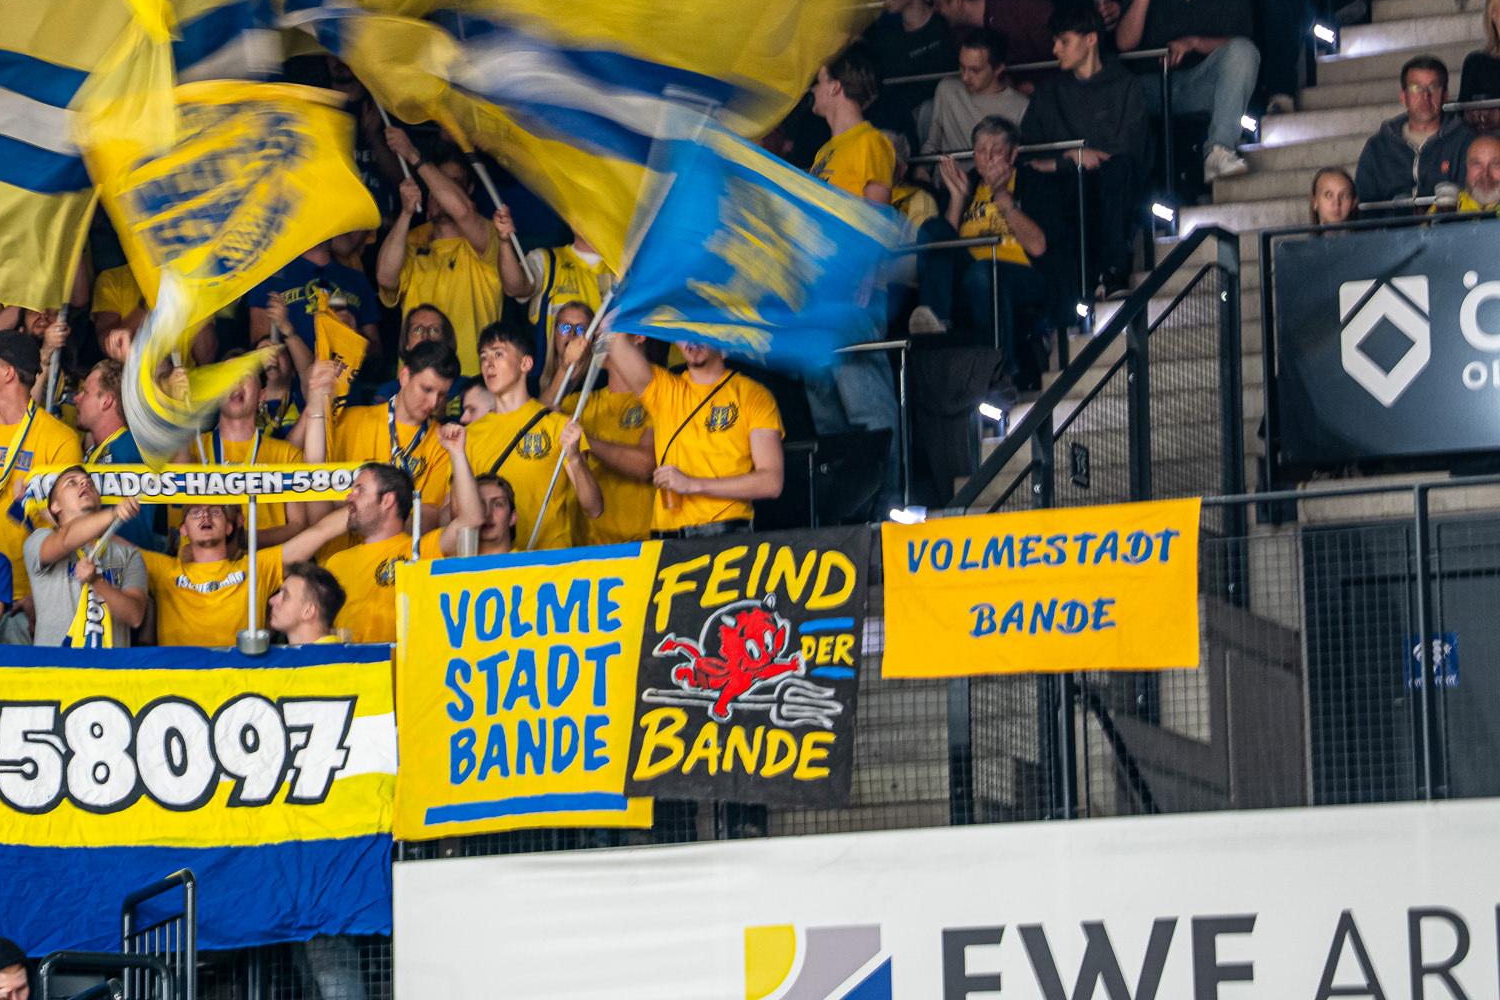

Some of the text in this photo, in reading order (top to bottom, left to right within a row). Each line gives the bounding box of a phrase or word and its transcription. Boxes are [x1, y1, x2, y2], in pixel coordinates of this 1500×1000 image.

[291, 468, 362, 494] 580
[906, 526, 1180, 574] VOLMESTADT
[439, 576, 625, 649] VOLME
[652, 541, 858, 634] FEIND
[968, 596, 1117, 638] BANDE
[444, 640, 622, 723] STADT
[801, 633, 856, 667] DER
[448, 713, 611, 786] BANDE
[631, 706, 838, 782] BANDE
[1314, 905, 1500, 1000] AR
